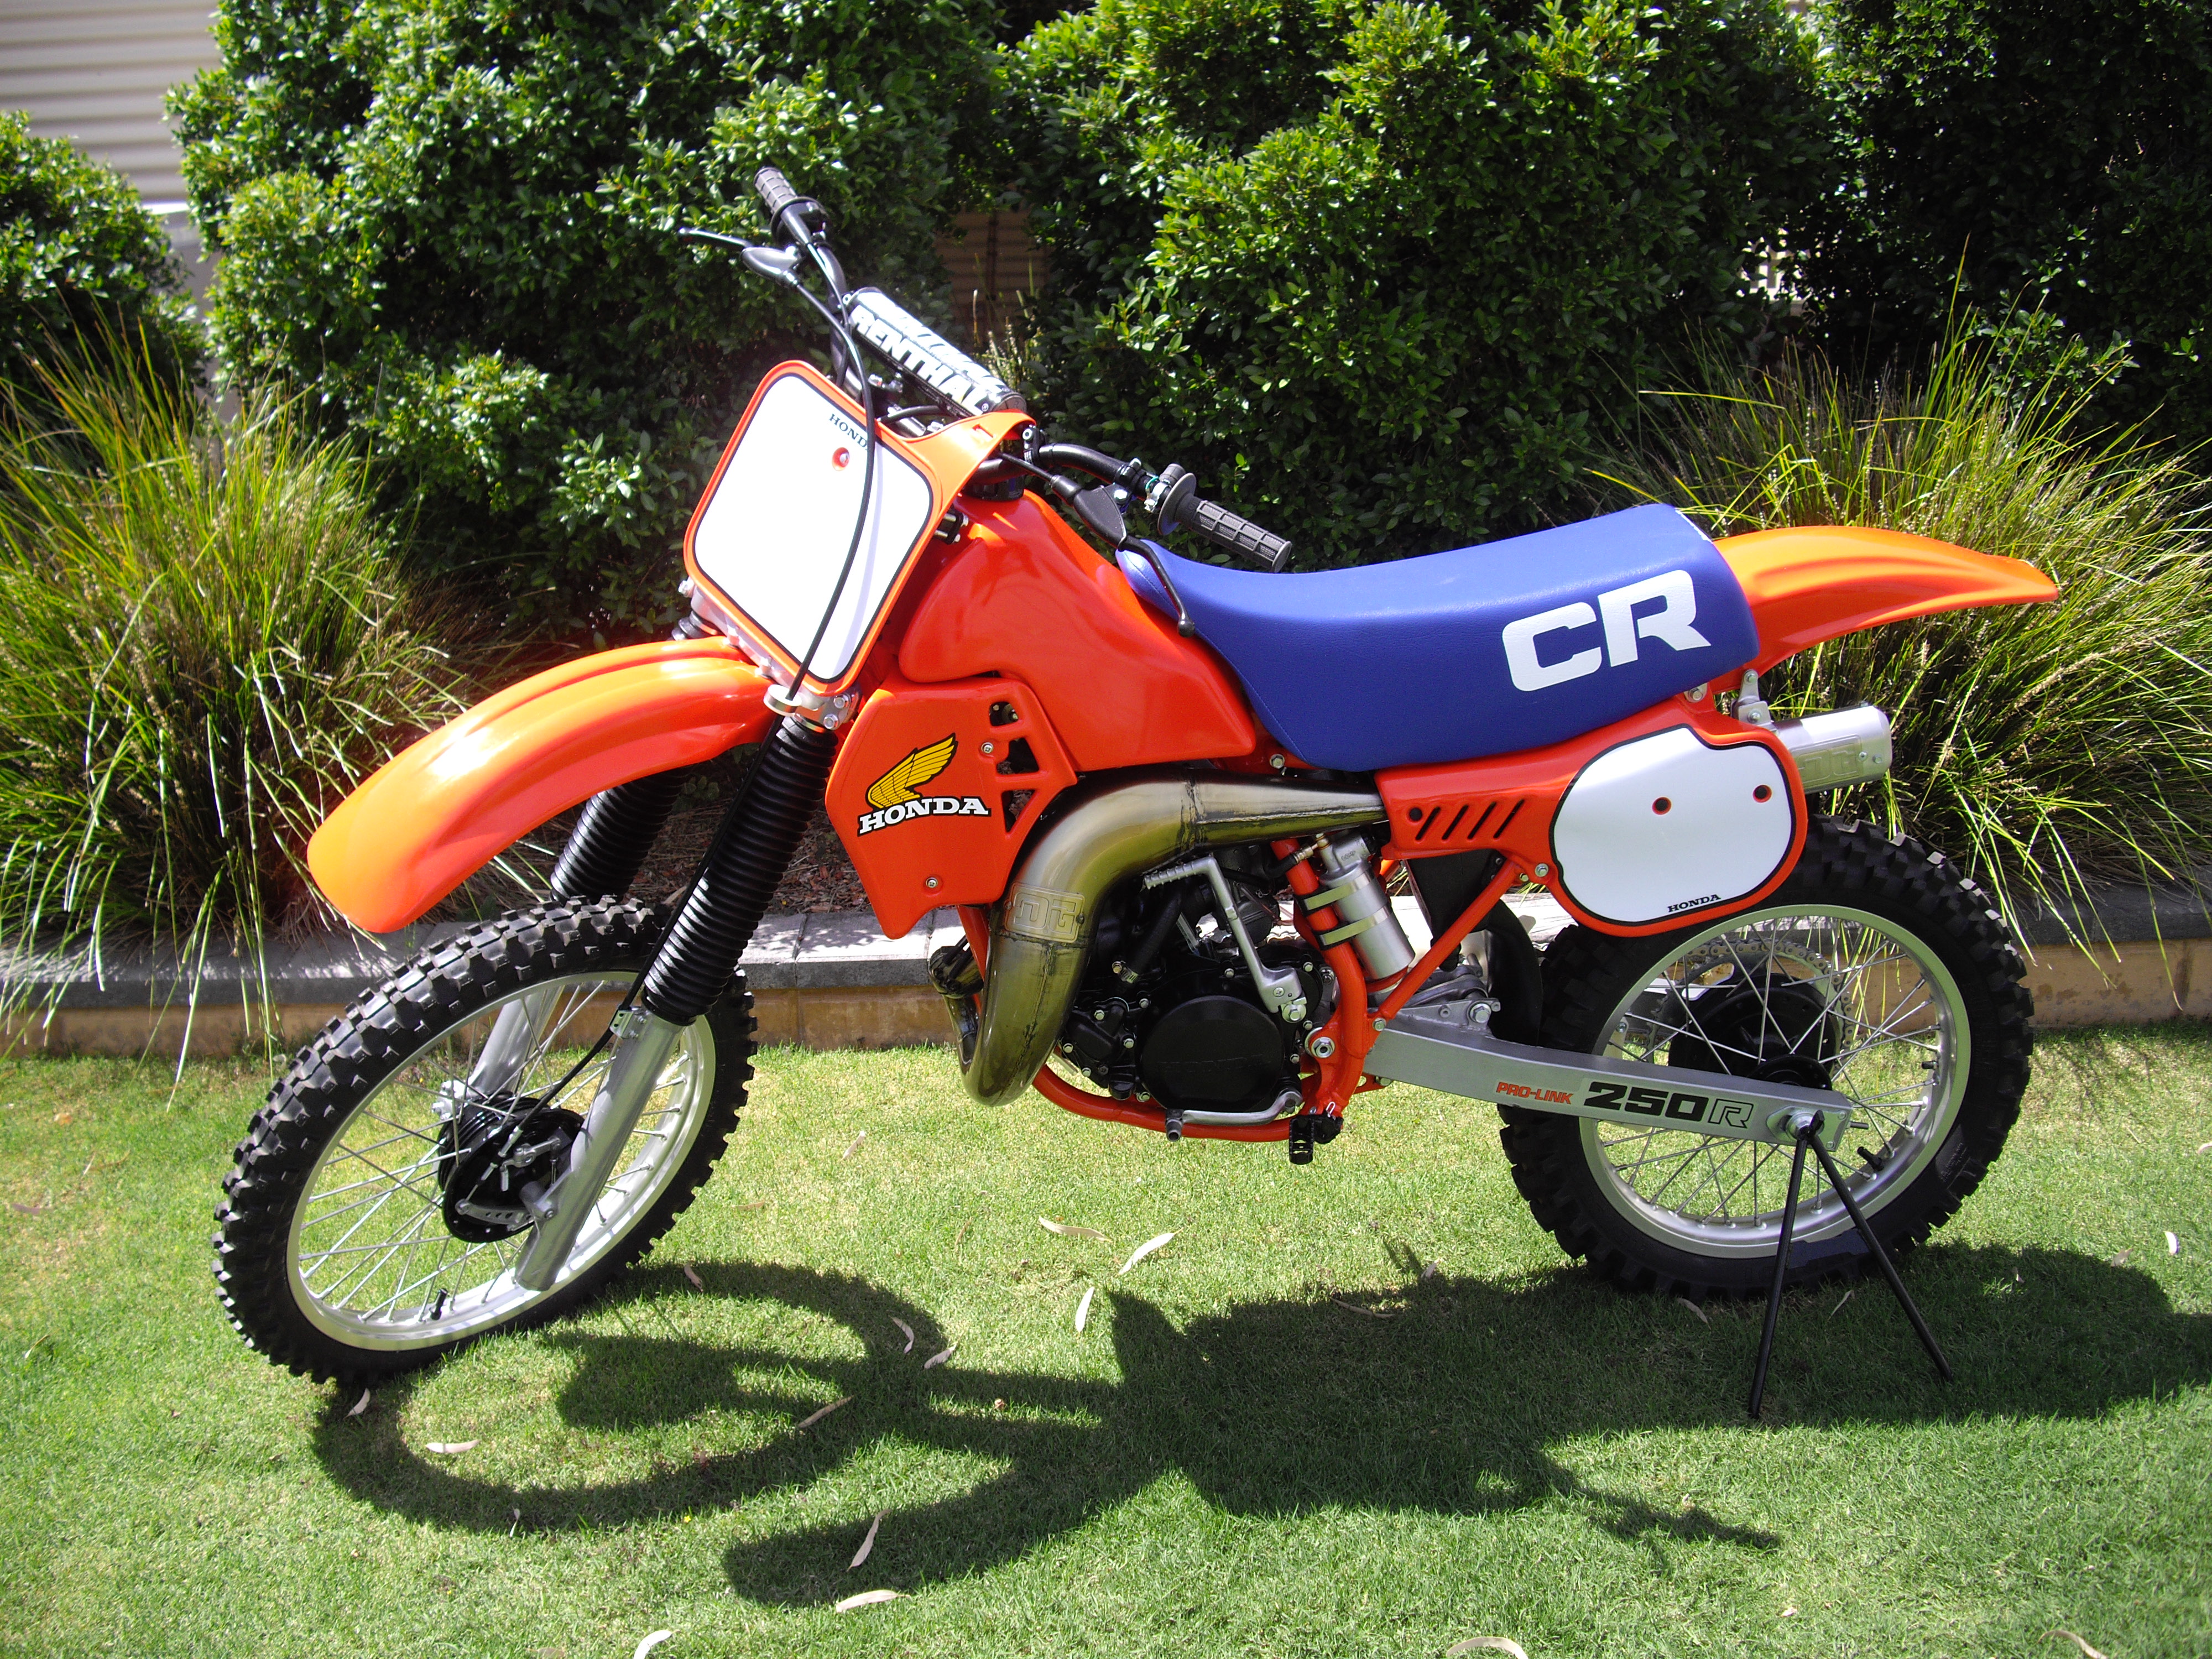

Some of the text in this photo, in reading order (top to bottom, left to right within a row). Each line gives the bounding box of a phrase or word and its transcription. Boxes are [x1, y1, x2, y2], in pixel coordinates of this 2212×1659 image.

[848, 305, 983, 415] RENTHAL
[829, 414, 868, 451] HOND
[1502, 570, 1712, 691] CR
[859, 797, 989, 834] HONDA
[1667, 894, 1721, 912] HONDA
[1496, 1081, 1754, 1129] PRO-LINK 250R
